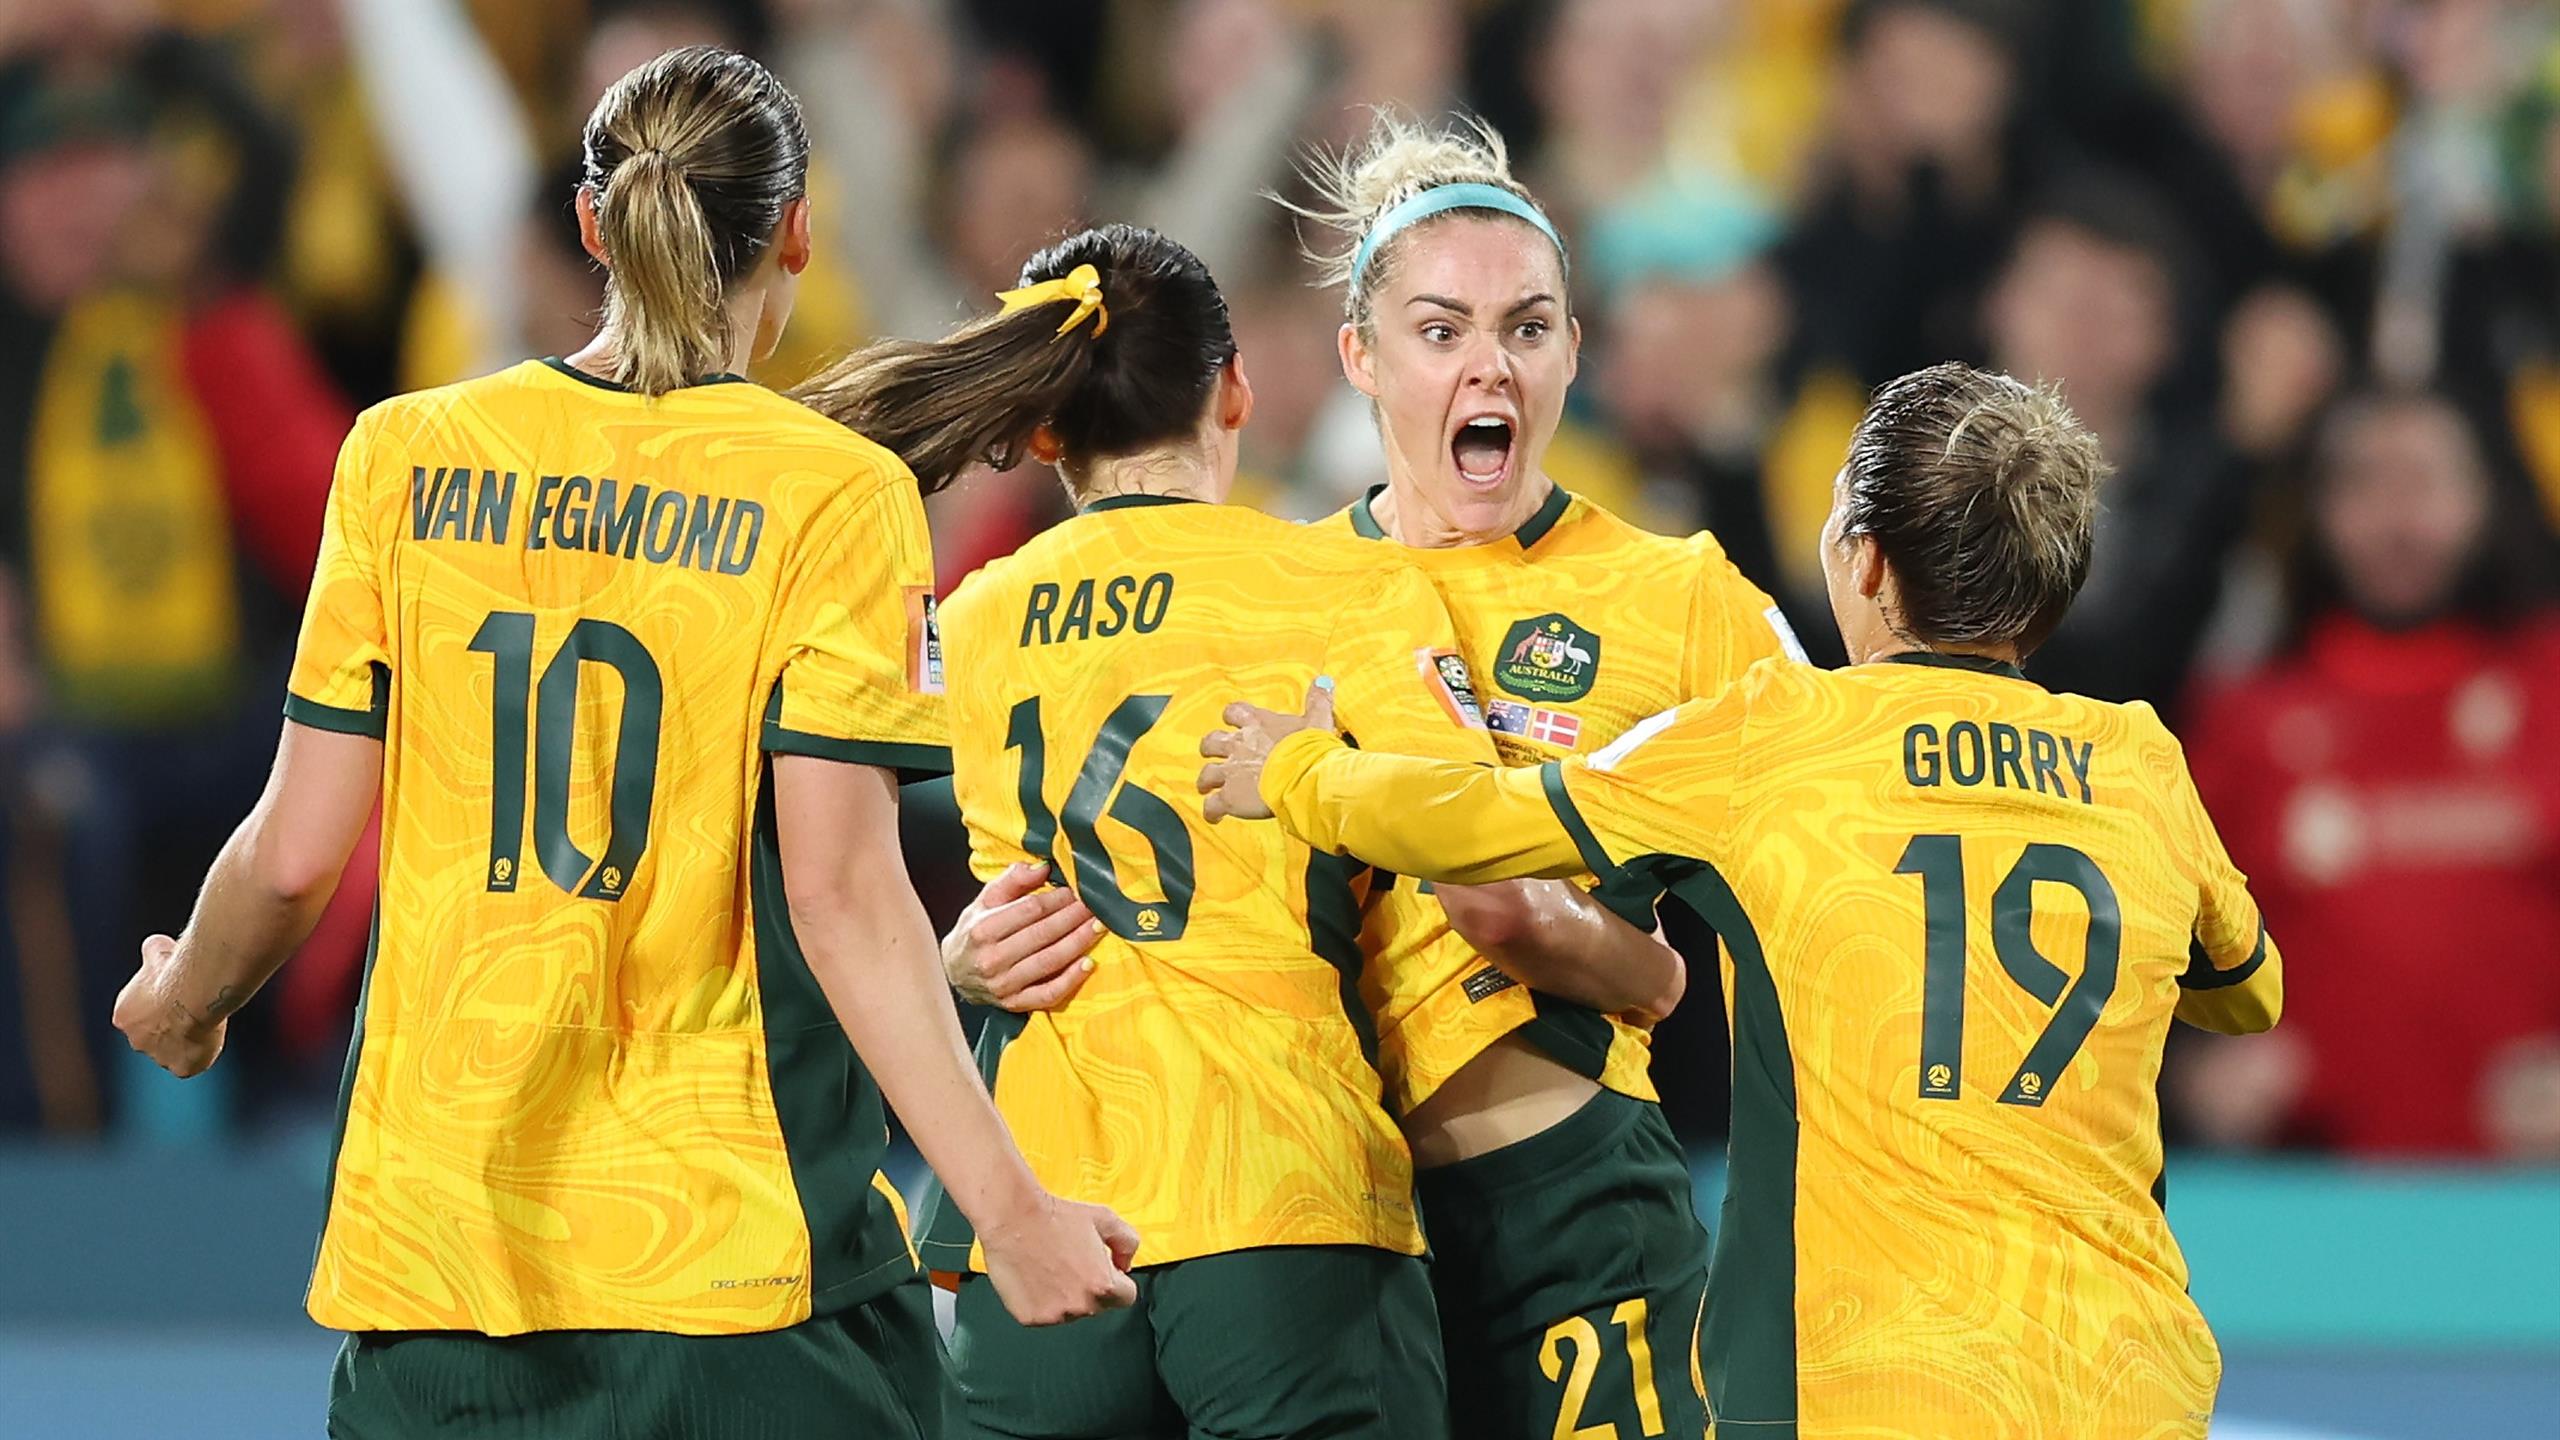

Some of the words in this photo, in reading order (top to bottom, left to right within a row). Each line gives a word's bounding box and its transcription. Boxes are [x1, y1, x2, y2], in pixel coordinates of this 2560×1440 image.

[412, 466, 517, 545] VAN
[527, 475, 765, 577] EGMOND
[1020, 572, 1175, 648] RASO
[1508, 664, 1576, 685] AUSTRALIA
[466, 610, 664, 903] 10
[1004, 694, 1197, 942] 16
[1903, 720, 2094, 805] GORRY
[1892, 834, 2122, 1108] 19
[1538, 1298, 1665, 1440] 21
